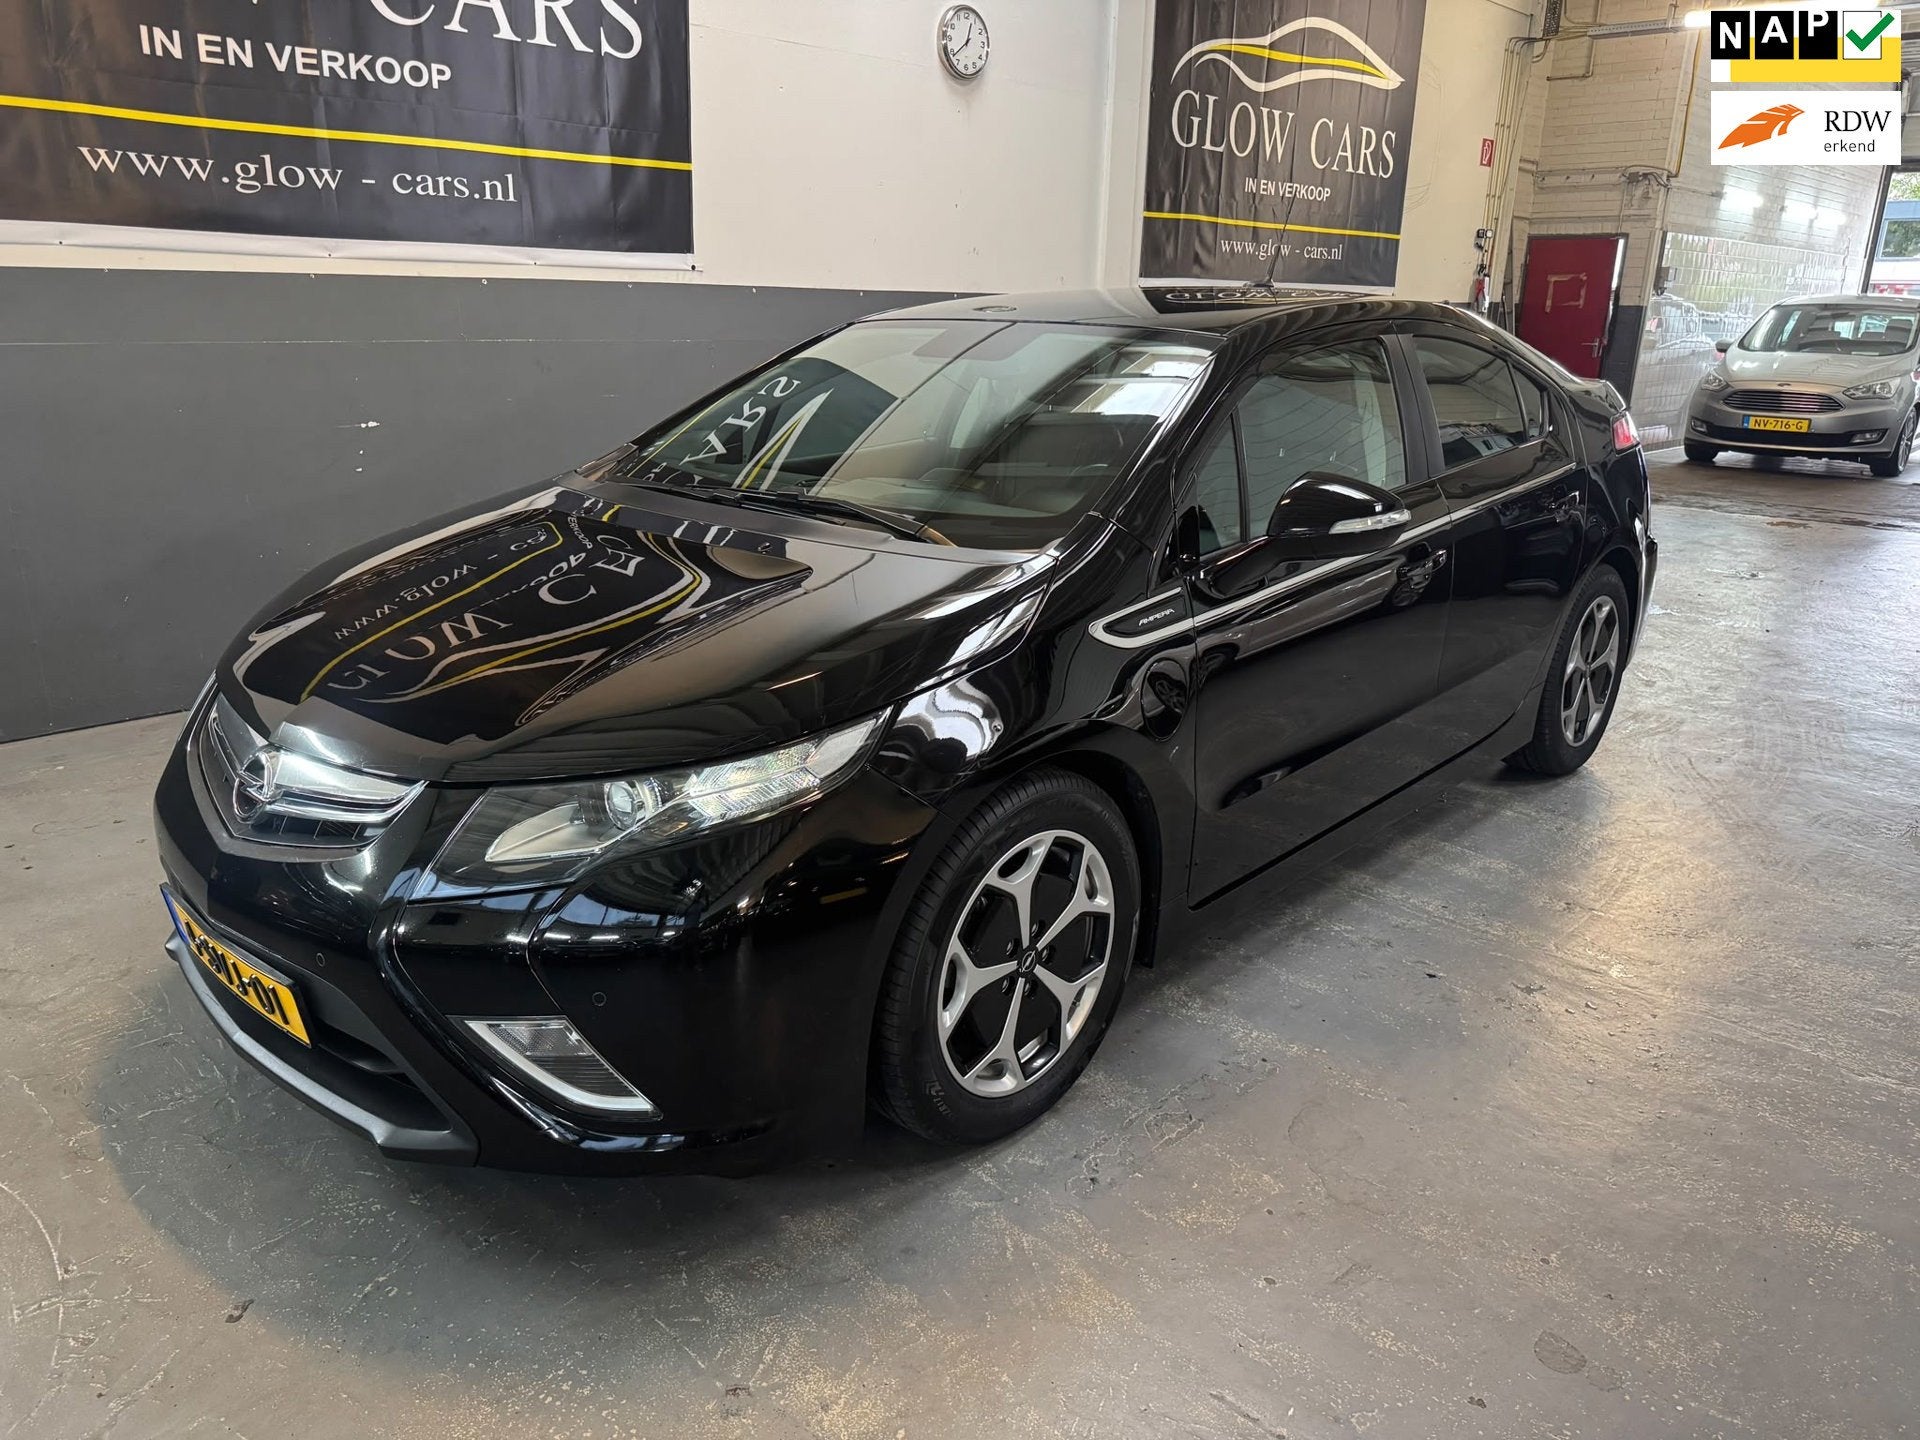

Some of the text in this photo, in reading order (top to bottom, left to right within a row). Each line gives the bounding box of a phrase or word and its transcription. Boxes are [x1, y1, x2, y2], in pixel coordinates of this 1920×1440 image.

[963, 12, 970, 20] 12
[371, 0, 642, 59] RS
[139, 24, 451, 89] IN EN VERKOOP
[1171, 89, 1397, 179] GLOW CARS
[77, 146, 343, 194] www.glow
[392, 172, 518, 202] cars.nl
[1244, 177, 1331, 202] IN EN VERKOOP
[1304, 244, 1343, 260] cars.nl
[1753, 418, 1803, 431] NV-716-G
[1138, 608, 1175, 626] AMPERA
